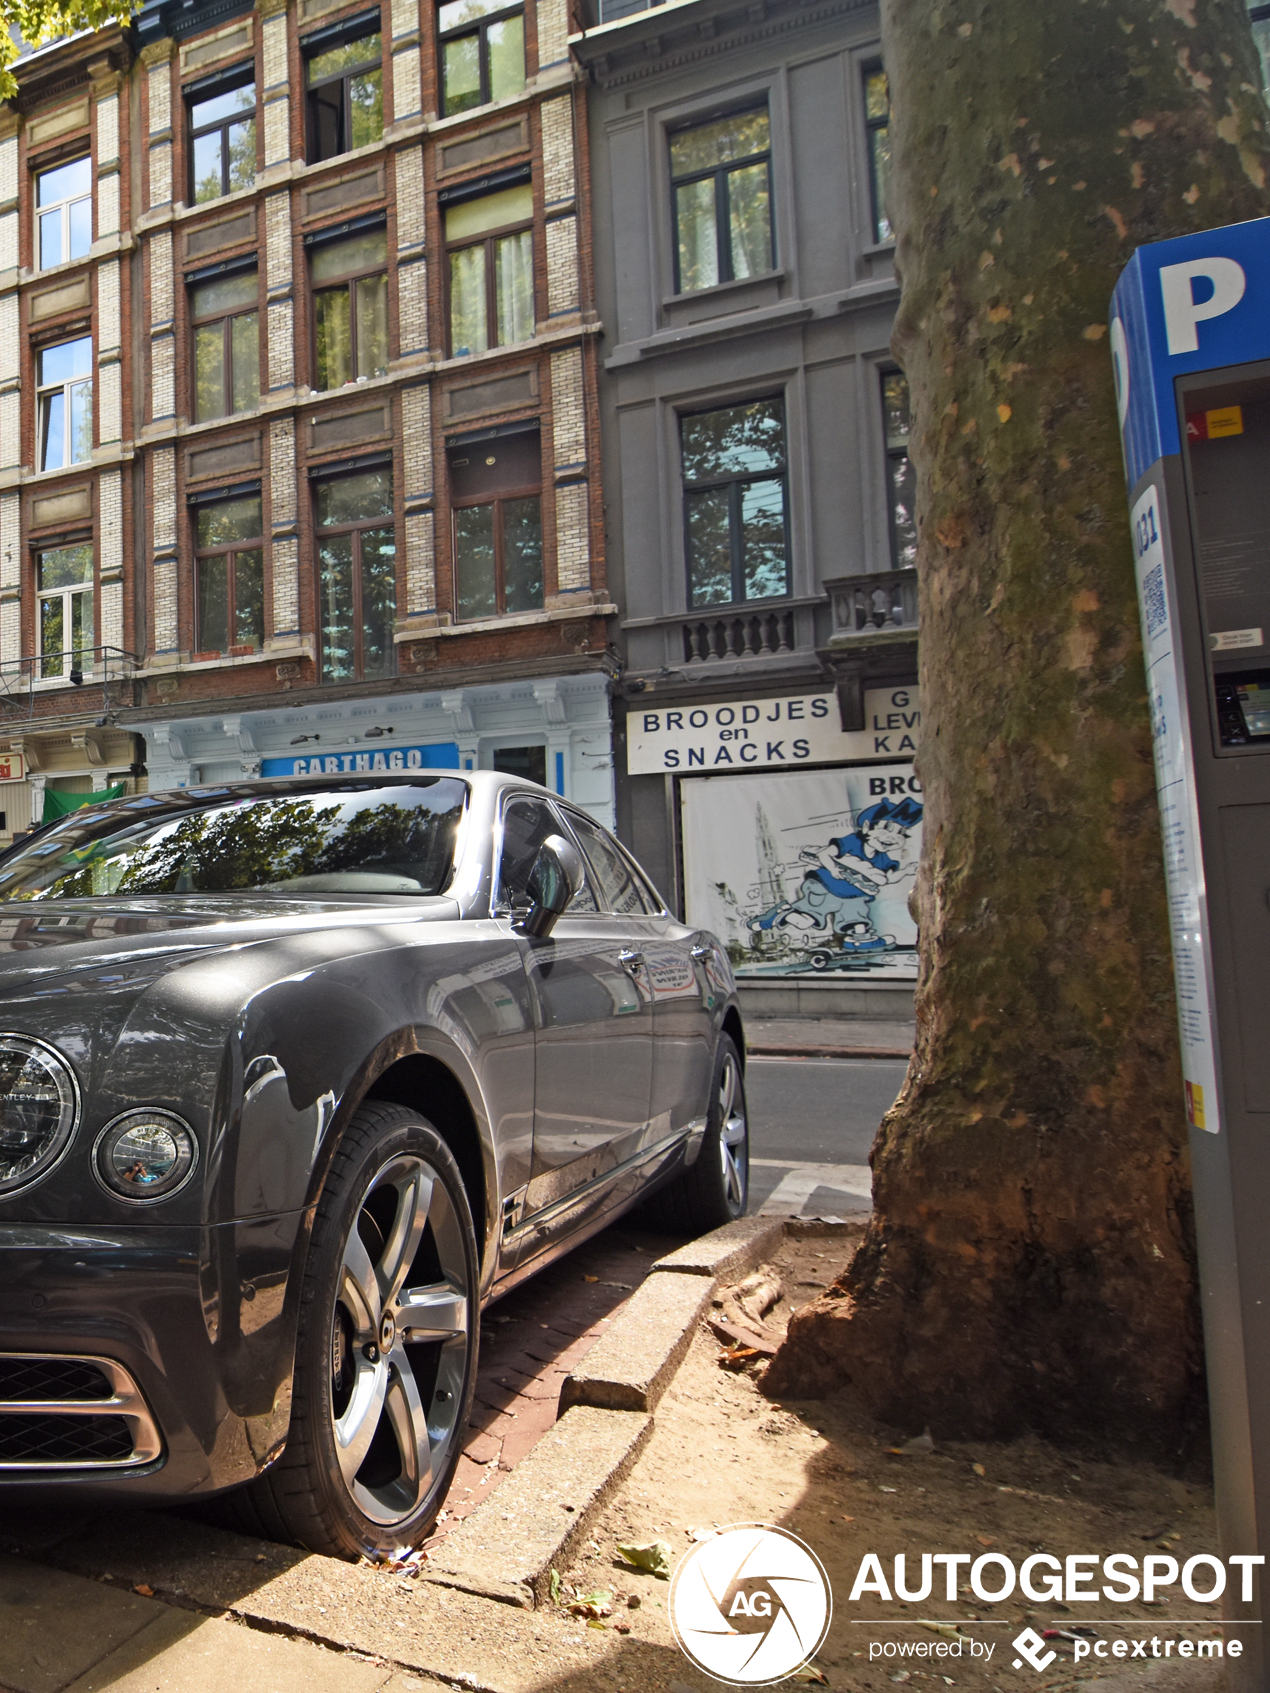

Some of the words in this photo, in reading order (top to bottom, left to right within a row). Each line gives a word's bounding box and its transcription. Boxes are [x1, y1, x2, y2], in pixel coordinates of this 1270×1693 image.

[1159, 257, 1246, 355] P
[643, 699, 829, 732] BROODJES
[719, 727, 748, 741] en
[293, 750, 422, 775] CARTHAGO
[664, 739, 810, 767] SNACKS
